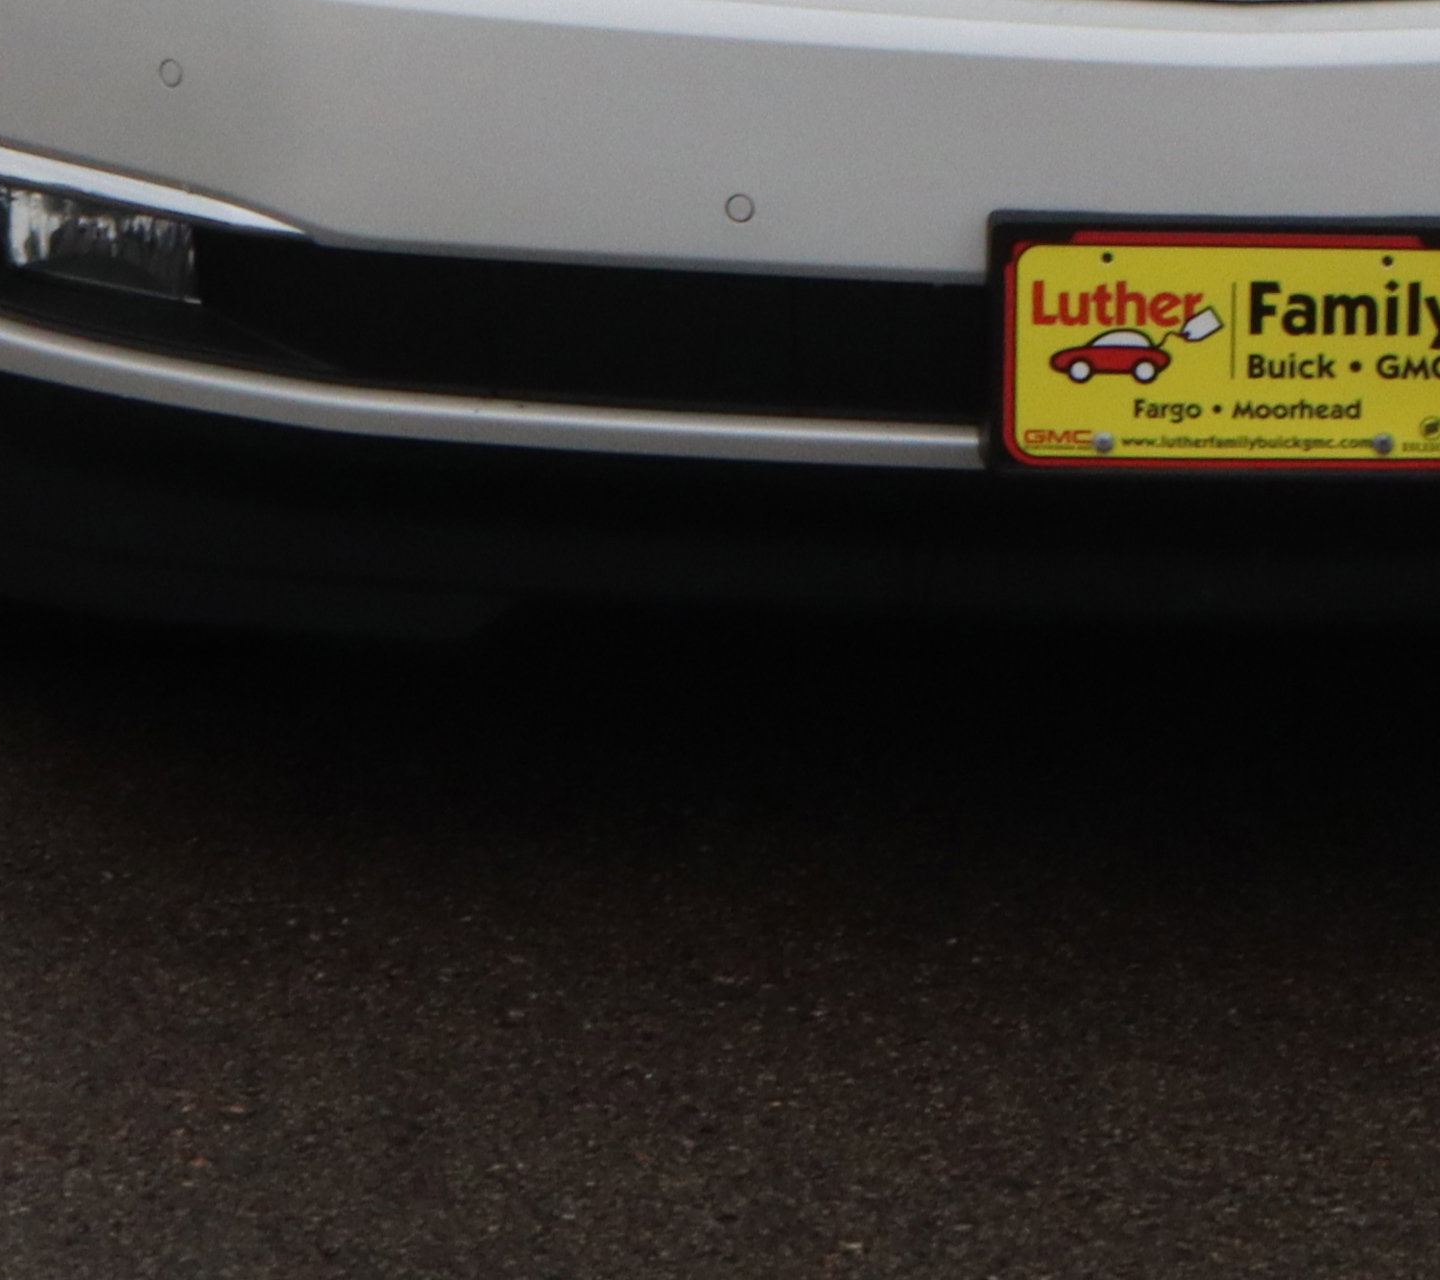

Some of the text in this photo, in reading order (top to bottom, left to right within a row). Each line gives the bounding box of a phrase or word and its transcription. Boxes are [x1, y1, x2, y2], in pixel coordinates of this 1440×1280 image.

[1032, 280, 1204, 327] Luther
[1247, 354, 1336, 380] Buick
[1133, 398, 1363, 424] Fargo Moorhead
[1023, 429, 1093, 445] GMC
